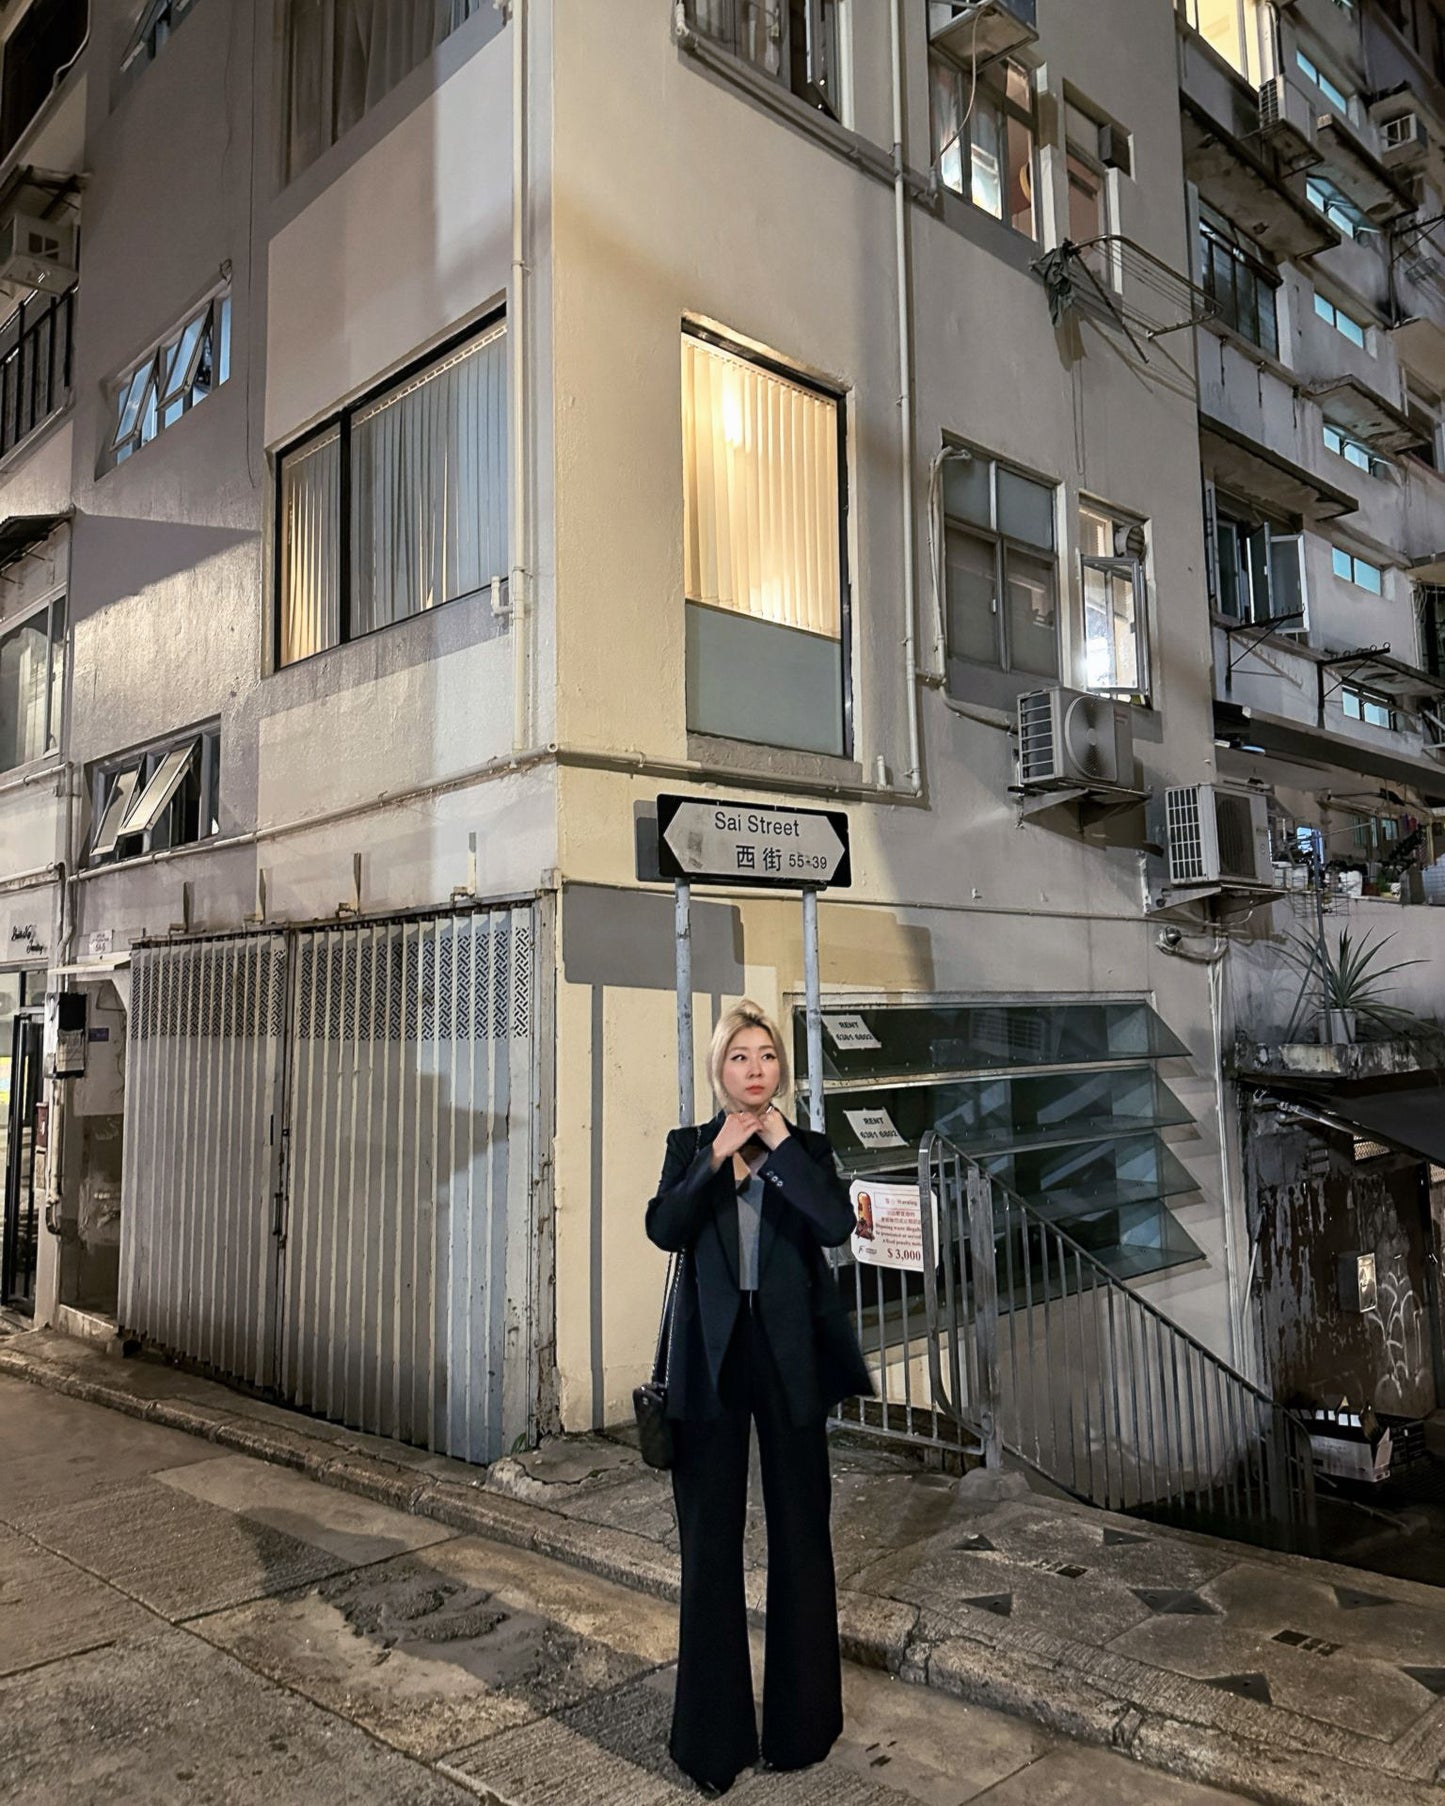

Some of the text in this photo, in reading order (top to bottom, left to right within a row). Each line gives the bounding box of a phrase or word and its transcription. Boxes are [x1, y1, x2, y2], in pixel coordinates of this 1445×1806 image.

[714, 811, 800, 837] Sai Street
[735, 845, 782, 872] 西街
[839, 1021, 859, 1029] RENT
[863, 1117, 884, 1125] RENT
[895, 1248, 922, 1261] 3,000
